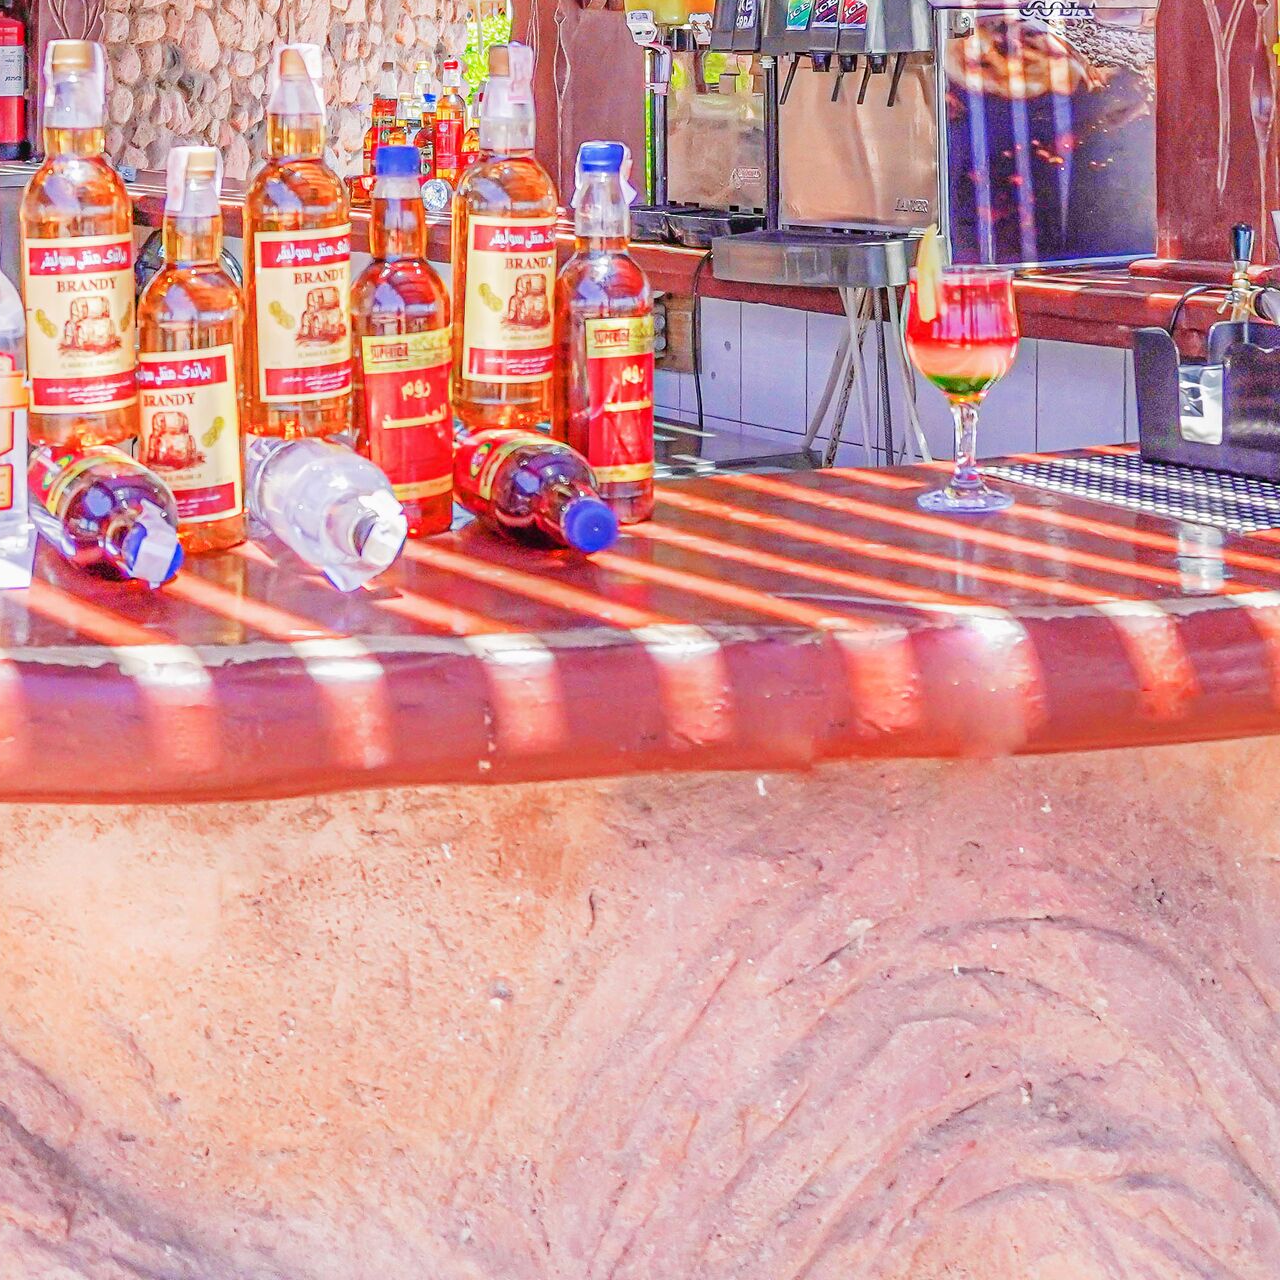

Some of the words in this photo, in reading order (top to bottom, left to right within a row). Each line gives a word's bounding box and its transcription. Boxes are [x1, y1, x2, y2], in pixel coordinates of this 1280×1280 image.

[789, 3, 810, 19] ICE
[845, 1, 865, 18] ICE
[505, 257, 552, 269] BRAND
[57, 277, 118, 293] BRANDY
[294, 269, 345, 285] BRANDY
[401, 379, 431, 401] روم
[144, 392, 196, 407] BRANDY
